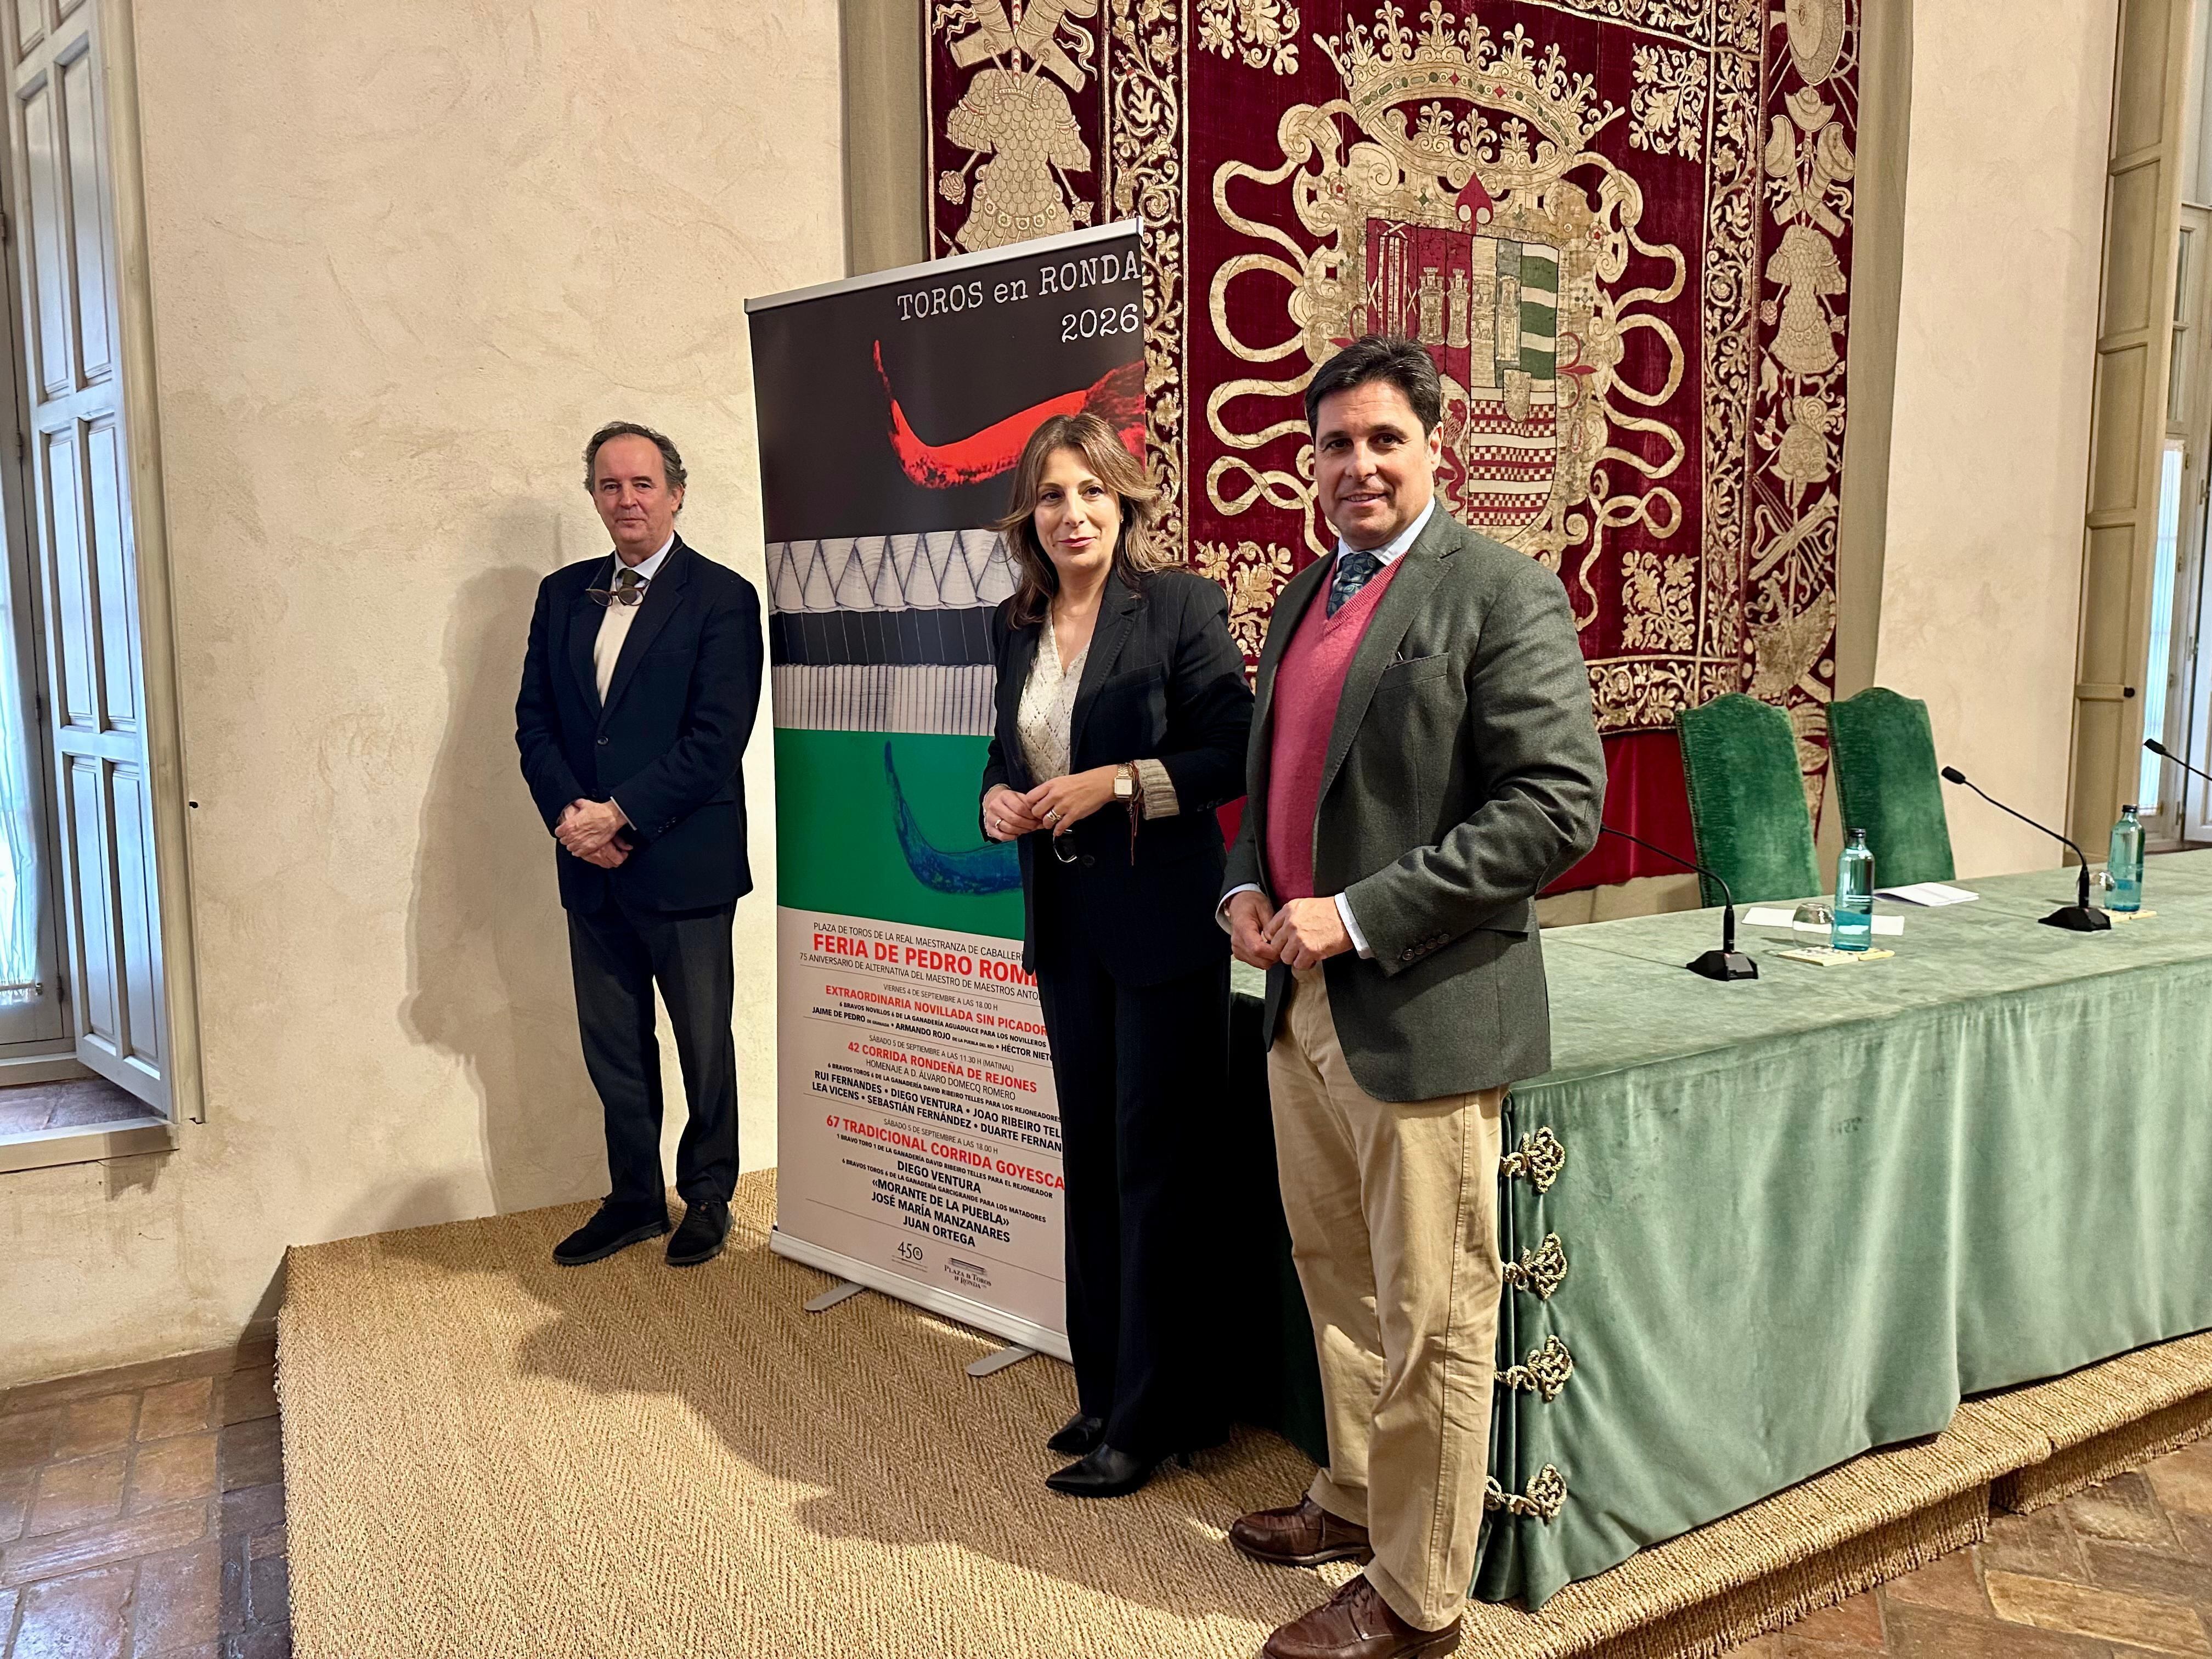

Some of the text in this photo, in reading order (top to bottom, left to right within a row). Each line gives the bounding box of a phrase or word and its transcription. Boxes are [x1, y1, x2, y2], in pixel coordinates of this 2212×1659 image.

[897, 251, 1141, 321] TOROS en RONDA
[1062, 303, 1139, 343] 2026
[814, 922, 978, 954] PLAZA DE TOROS DE LA REAL MAESTRANZA DE
[814, 934, 972, 975] FERIA DE PEDRO
[809, 955, 853, 967] ANIVERSARIO
[855, 961, 864, 969] DE
[865, 963, 909, 977] ALTERNATIVA
[911, 970, 924, 980] DEL
[926, 973, 960, 986] MAESTRO
[962, 979, 972, 988] DE
[974, 981, 1014, 996] MAESTROS
[883, 984, 906, 994] VIERNES
[921, 991, 956, 1003] SEPTIEMBRE
[976, 1001, 991, 1009] 18.00
[826, 985, 911, 1009] EXTRAORDINARIA
[915, 1001, 973, 1022] NOVILLADA
[977, 1013, 994, 1026] SIN
[844, 1002, 864, 1011] BRAVOS
[866, 1006, 890, 1016] NOVILLOS
[912, 1016, 944, 1027] GANADERÍA
[945, 1023, 978, 1034] AGUADULCE
[980, 1029, 995, 1037] PARA
[1010, 1035, 1046, 1047] NOVILLEROS
[812, 1007, 832, 1016] JAIME
[844, 1012, 865, 1022] PEDRO
[895, 1023, 931, 1036] ARMANDO
[933, 1030, 950, 1040] ROJO
[1002, 1043, 1031, 1057] HÉCTOR
[848, 1042, 1036, 1092] 42 CORRIDA RONDEÑA DE REJONES
[870, 1035, 891, 1045] SÁBADO
[906, 1043, 940, 1056] SEPTIEMBRE
[947, 1052, 958, 1060] LAS
[960, 1054, 975, 1064] 11.30
[983, 1059, 1014, 1073] (MATINAL)
[832, 1064, 853, 1073] BRAVOS
[854, 1068, 870, 1077] TOROS
[891, 1077, 922, 1089] GANADERÍA
[923, 1085, 940, 1093] DAVID
[942, 1089, 963, 1099] RIBEIRO
[964, 1094, 984, 1104] TELLES
[985, 1099, 1001, 1108] PARA
[866, 1059, 902, 1074] HOMENAJE
[919, 1070, 946, 1084] ÁLVARO
[949, 1077, 980, 1094] DOMECQ
[983, 1086, 1015, 1100] ROMERO
[812, 1082, 827, 1093] LEA
[830, 1085, 859, 1100] VICENS
[867, 1095, 914, 1114] SEBASTIÁN
[917, 1107, 971, 1128] FERNÁNDEZ
[981, 1123, 1018, 1141] DUARTE
[815, 1070, 828, 1081] RUI
[832, 1074, 882, 1093] FERNANDES
[891, 1088, 918, 1102] DIEGO
[920, 1095, 963, 1114] VENTURA
[973, 1108, 998, 1122] JOAO
[1002, 1115, 1041, 1133] RIBEIRO
[827, 1115, 1065, 1191] 67 TRADICIONAL CORRIDA GOYESCA
[884, 1119, 906, 1130] SÁBADO
[913, 1126, 920, 1134] DE
[922, 1128, 956, 1143] SEPTIEMBRE
[963, 1139, 974, 1148] LAS
[977, 1143, 992, 1153] 18.00
[841, 1135, 857, 1143] BRAVO
[859, 1139, 872, 1148] TORO
[894, 1149, 924, 1162] GANADERÍA
[926, 1158, 943, 1167] DAVID
[944, 1163, 966, 1173] RIBEIRO
[967, 1169, 986, 1180] TELLES
[988, 1175, 1003, 1184] PARA
[1013, 1182, 1052, 1198] REJONEADOR
[898, 1160, 981, 1193] DIEGO VENTURA
[847, 1159, 866, 1170] BRAVOS
[867, 1165, 883, 1175] TOROS
[905, 1177, 936, 1190] GANADERÍA
[938, 1186, 978, 1203] GARCIGRANDE
[980, 1198, 995, 1207] PARA
[1009, 1207, 1046, 1222] MATADORES
[872, 1179, 1009, 1226] «MORANTE DE LA PUEBLA»
[872, 1192, 1009, 1242] JOSÉ MARÍA MANZANARES
[903, 1216, 975, 1246] JUAN ORTEGA
[898, 1242, 923, 1260] 450
